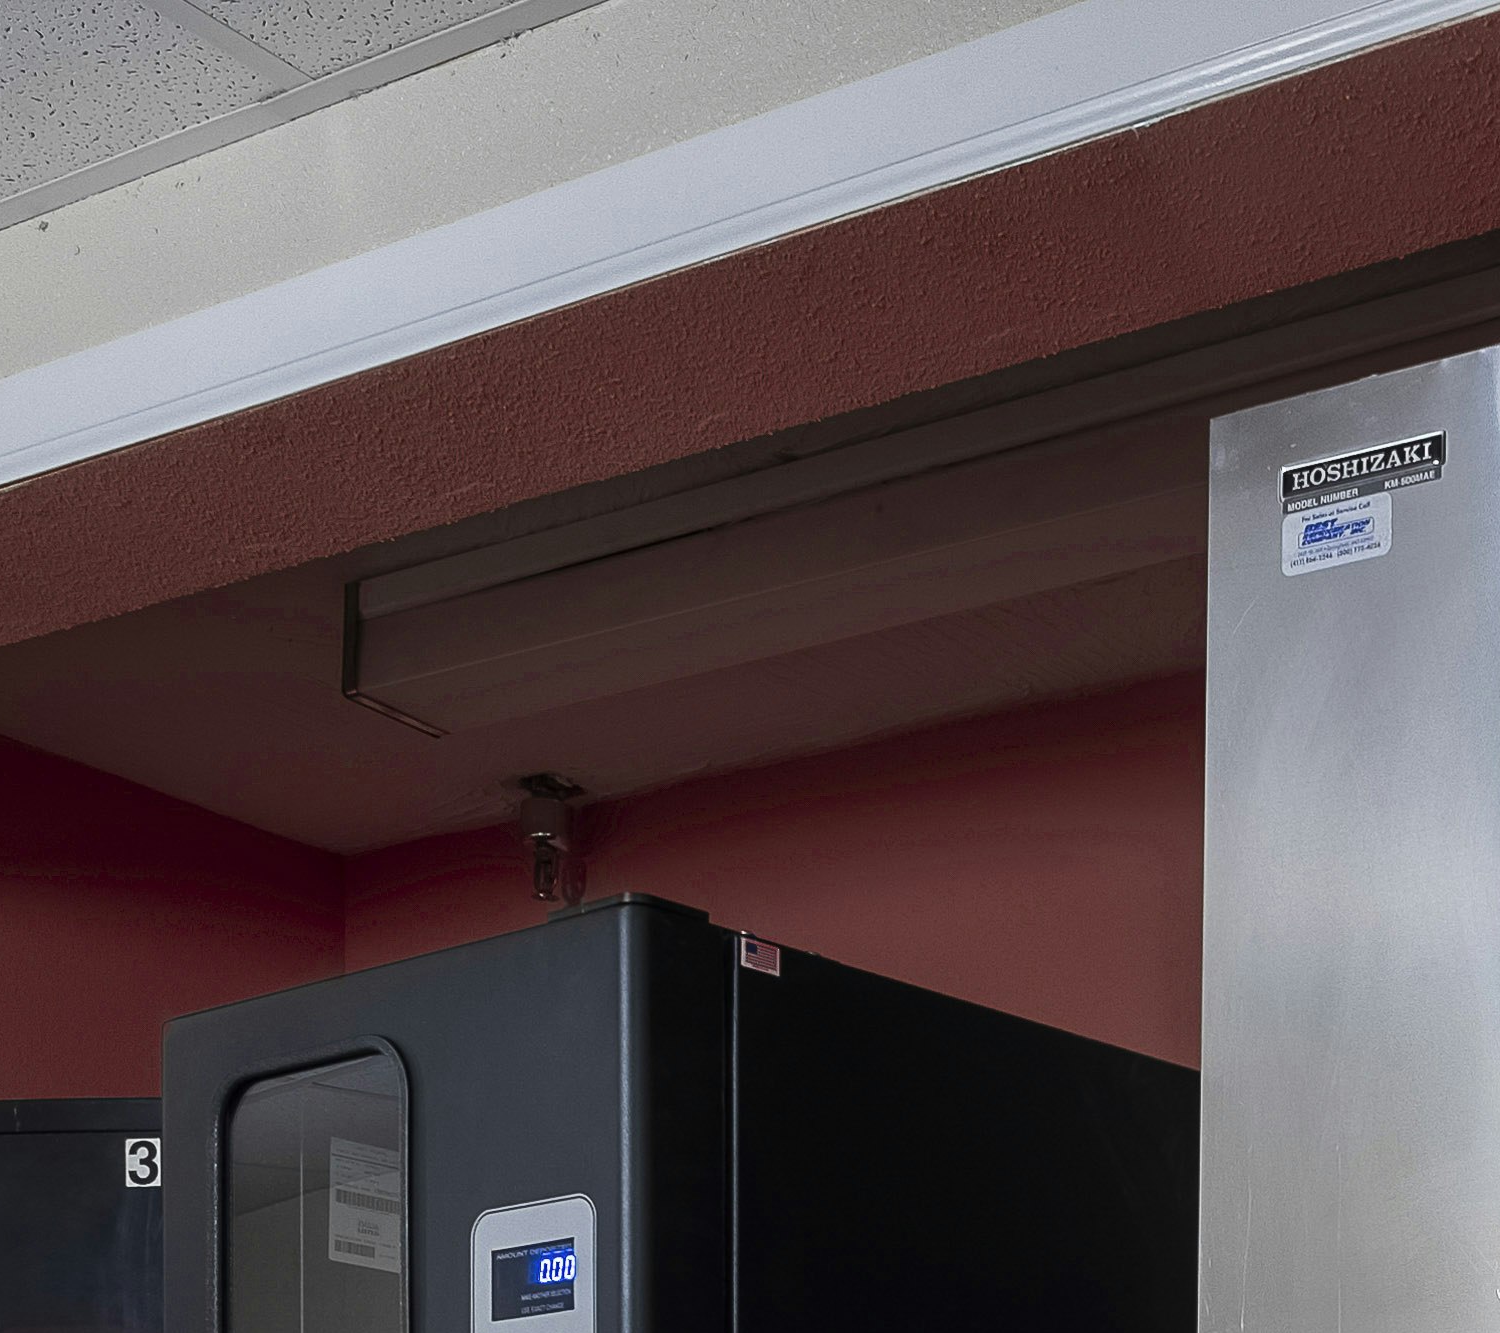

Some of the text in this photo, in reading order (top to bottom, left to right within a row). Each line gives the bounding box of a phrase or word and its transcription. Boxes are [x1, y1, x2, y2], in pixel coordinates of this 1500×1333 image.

[1292, 442, 1432, 490] HOSHIZAKI
[1287, 497, 1318, 512] MODEL
[1320, 487, 1359, 504] NUMBER
[128, 1140, 159, 1185] 3
[496, 1250, 528, 1260] AMOUNT
